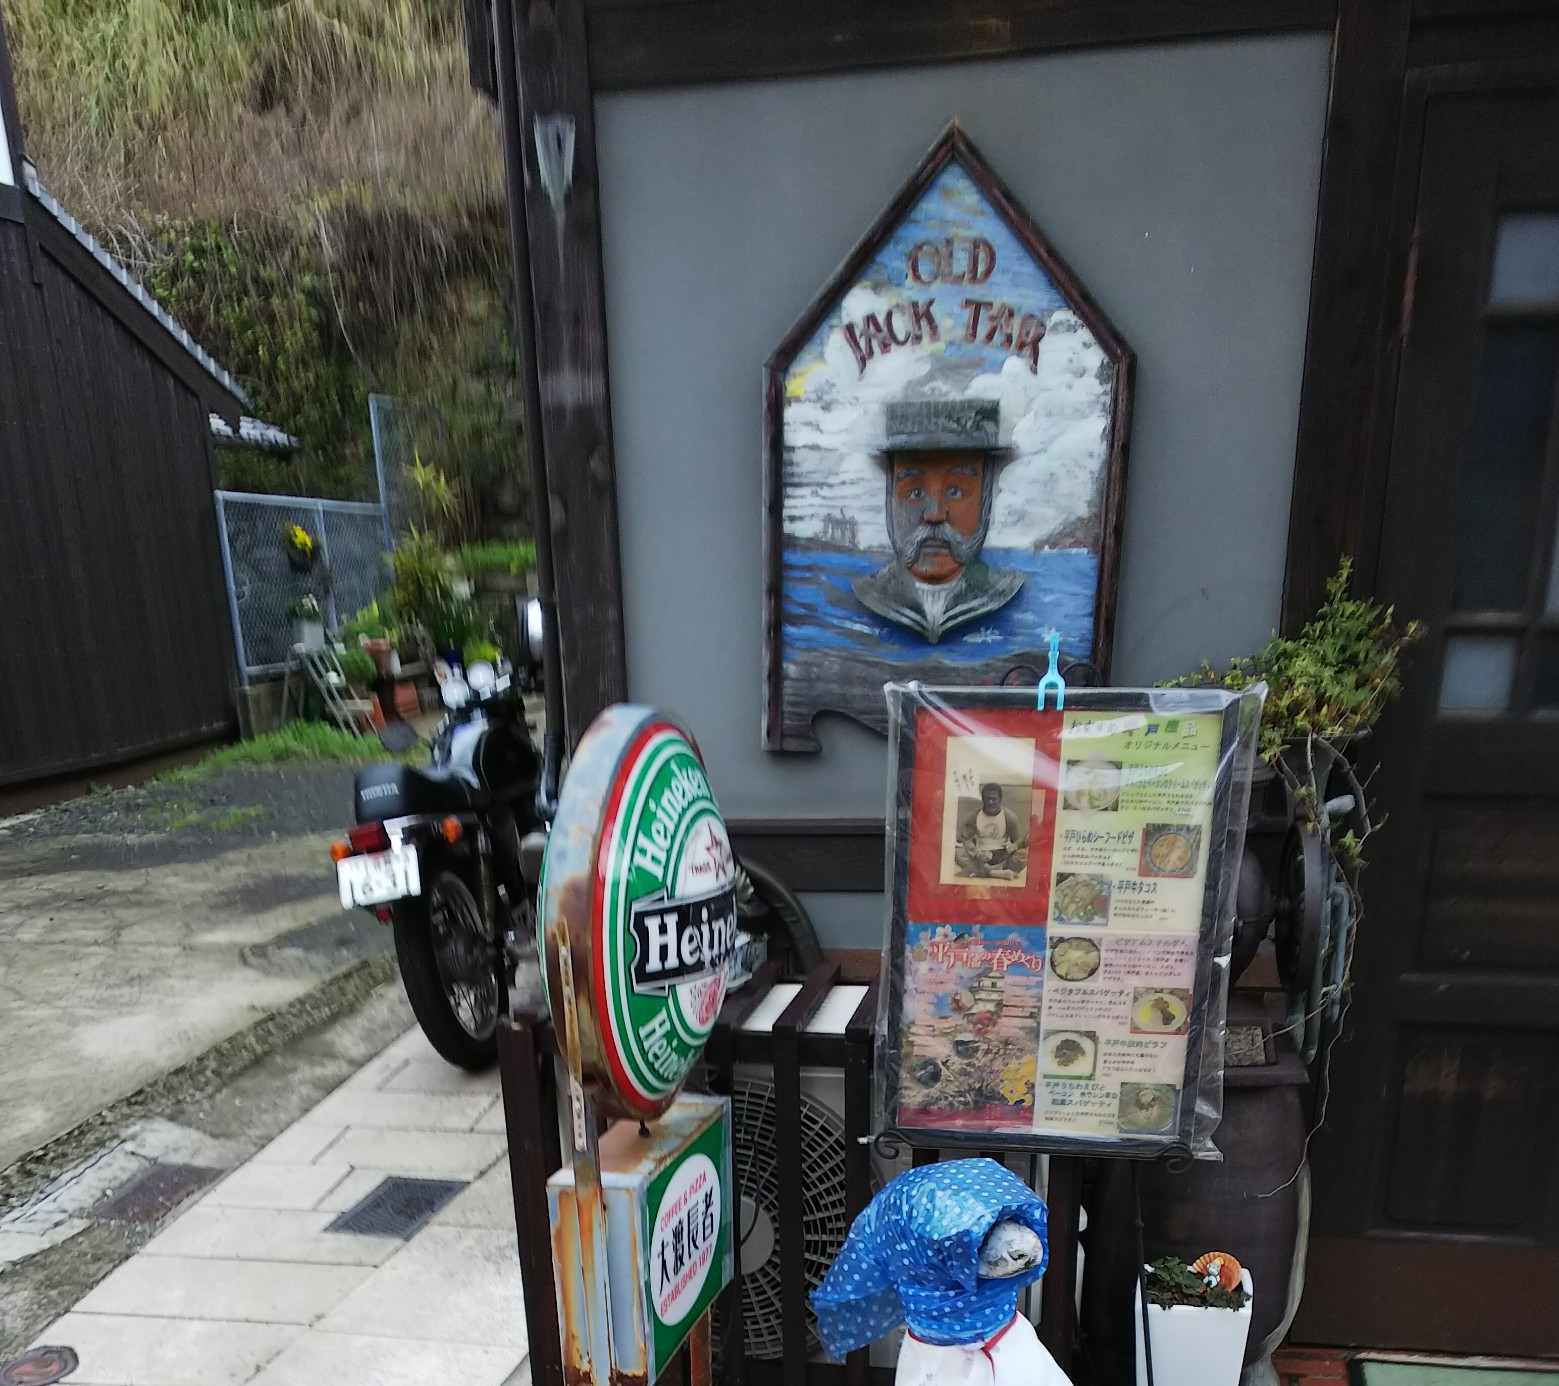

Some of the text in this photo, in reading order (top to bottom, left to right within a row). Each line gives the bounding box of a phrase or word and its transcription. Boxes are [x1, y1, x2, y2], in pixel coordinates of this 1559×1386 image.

[907, 236, 996, 286] OLD
[843, 297, 1047, 379] JACK TAR
[1123, 740, 1211, 751] オリジナルメニュー
[644, 893, 737, 973] Heine
[660, 1195, 682, 1232] COFFEE
[689, 1170, 707, 1199] PIZZA
[660, 1261, 698, 1319] ESTABLISHED
